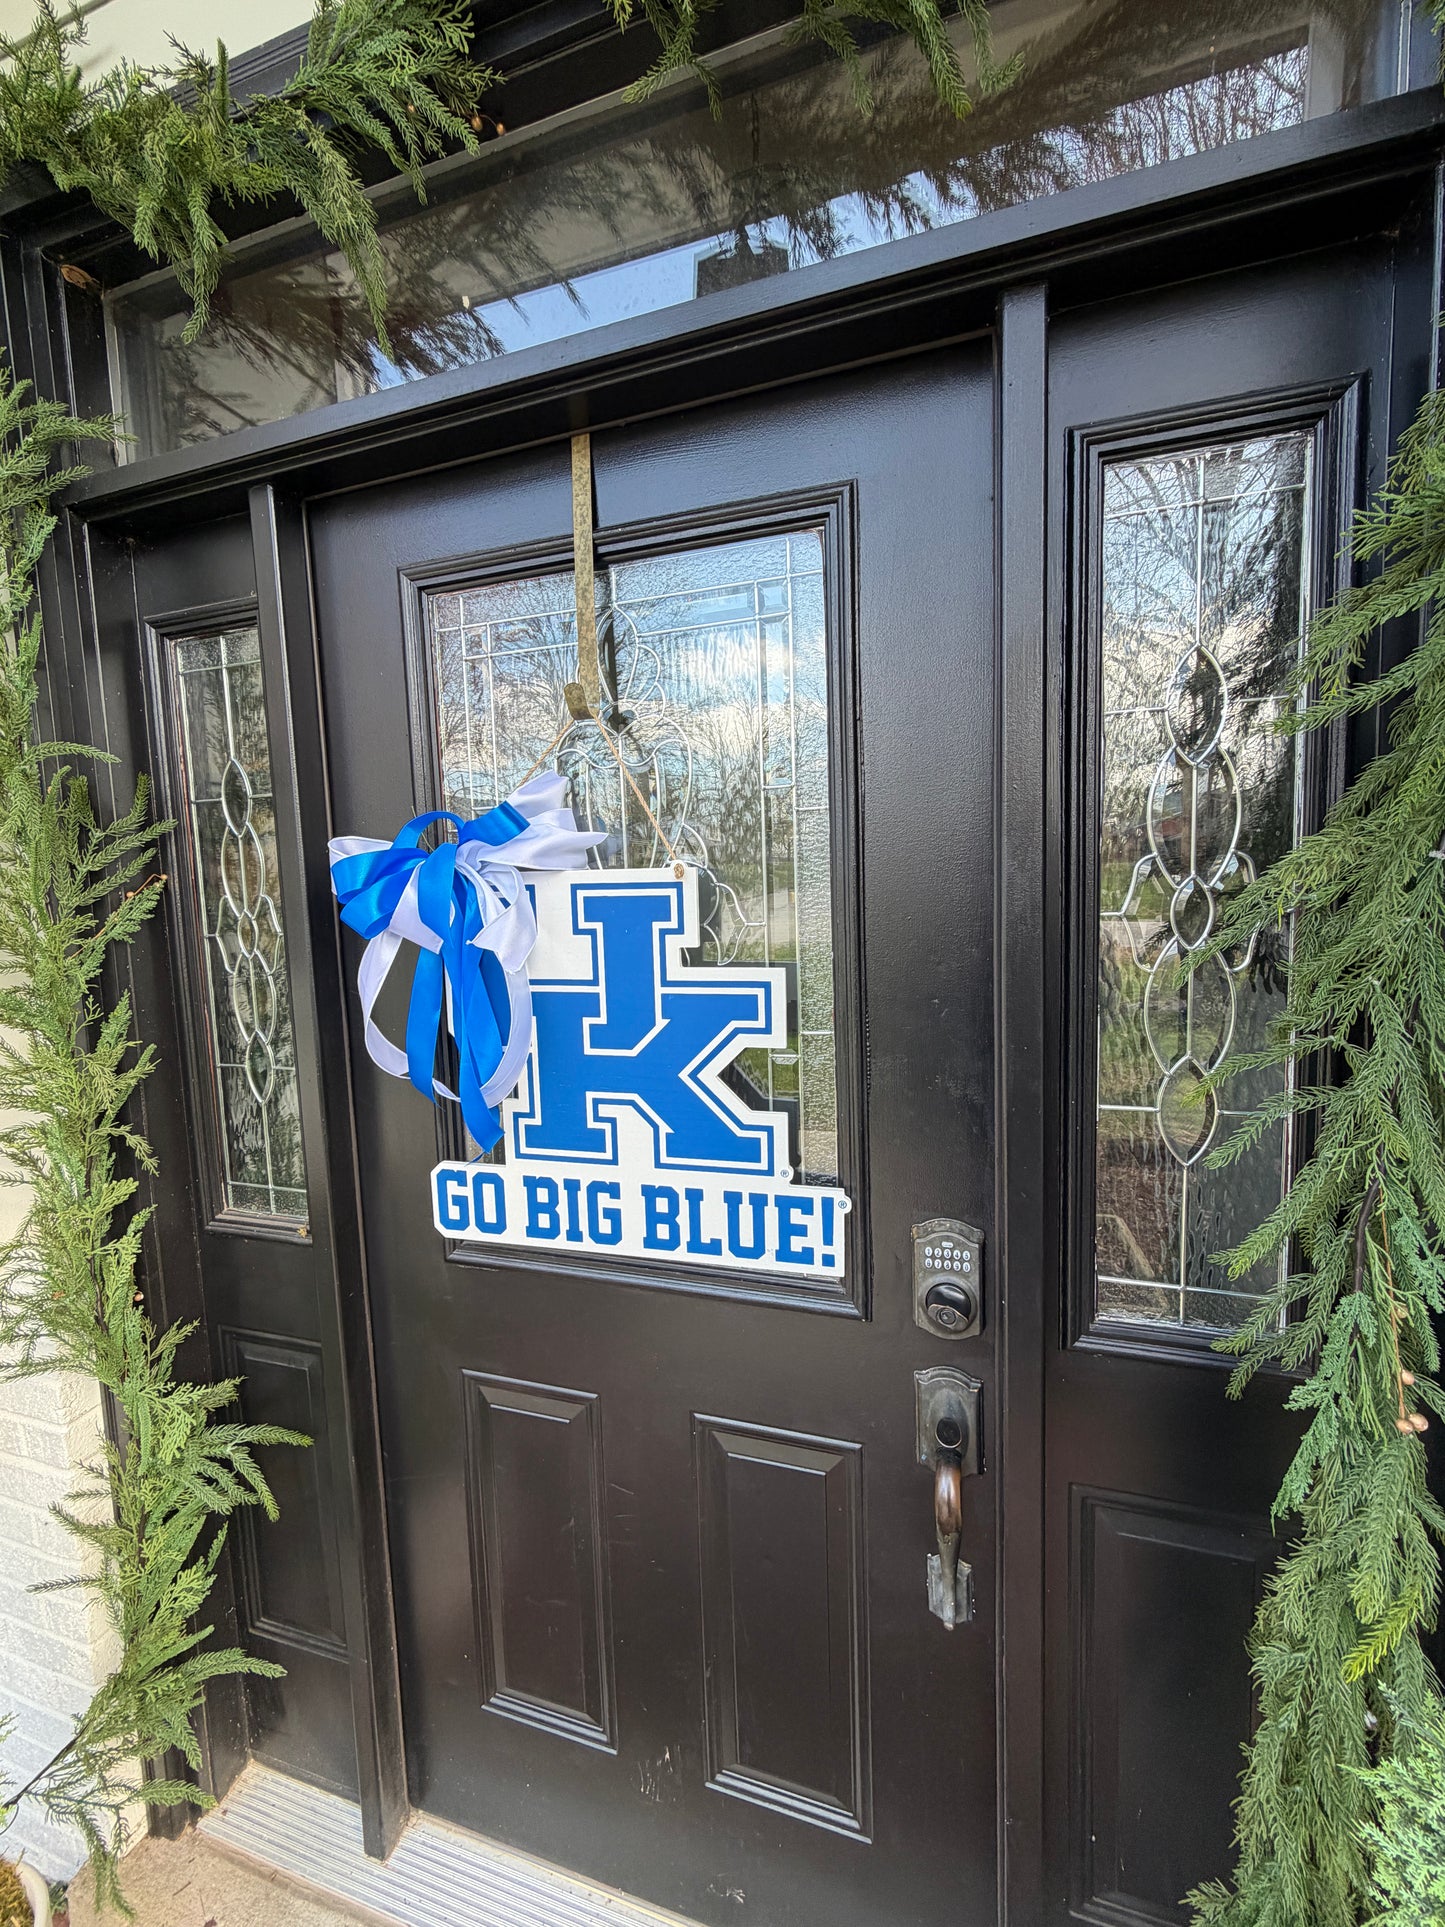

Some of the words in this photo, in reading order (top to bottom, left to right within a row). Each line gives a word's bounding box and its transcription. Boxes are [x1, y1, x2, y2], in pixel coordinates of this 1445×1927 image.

[435, 1168, 507, 1235] GO
[522, 1175, 623, 1246] BIG
[640, 1184, 836, 1268] BLUE!
